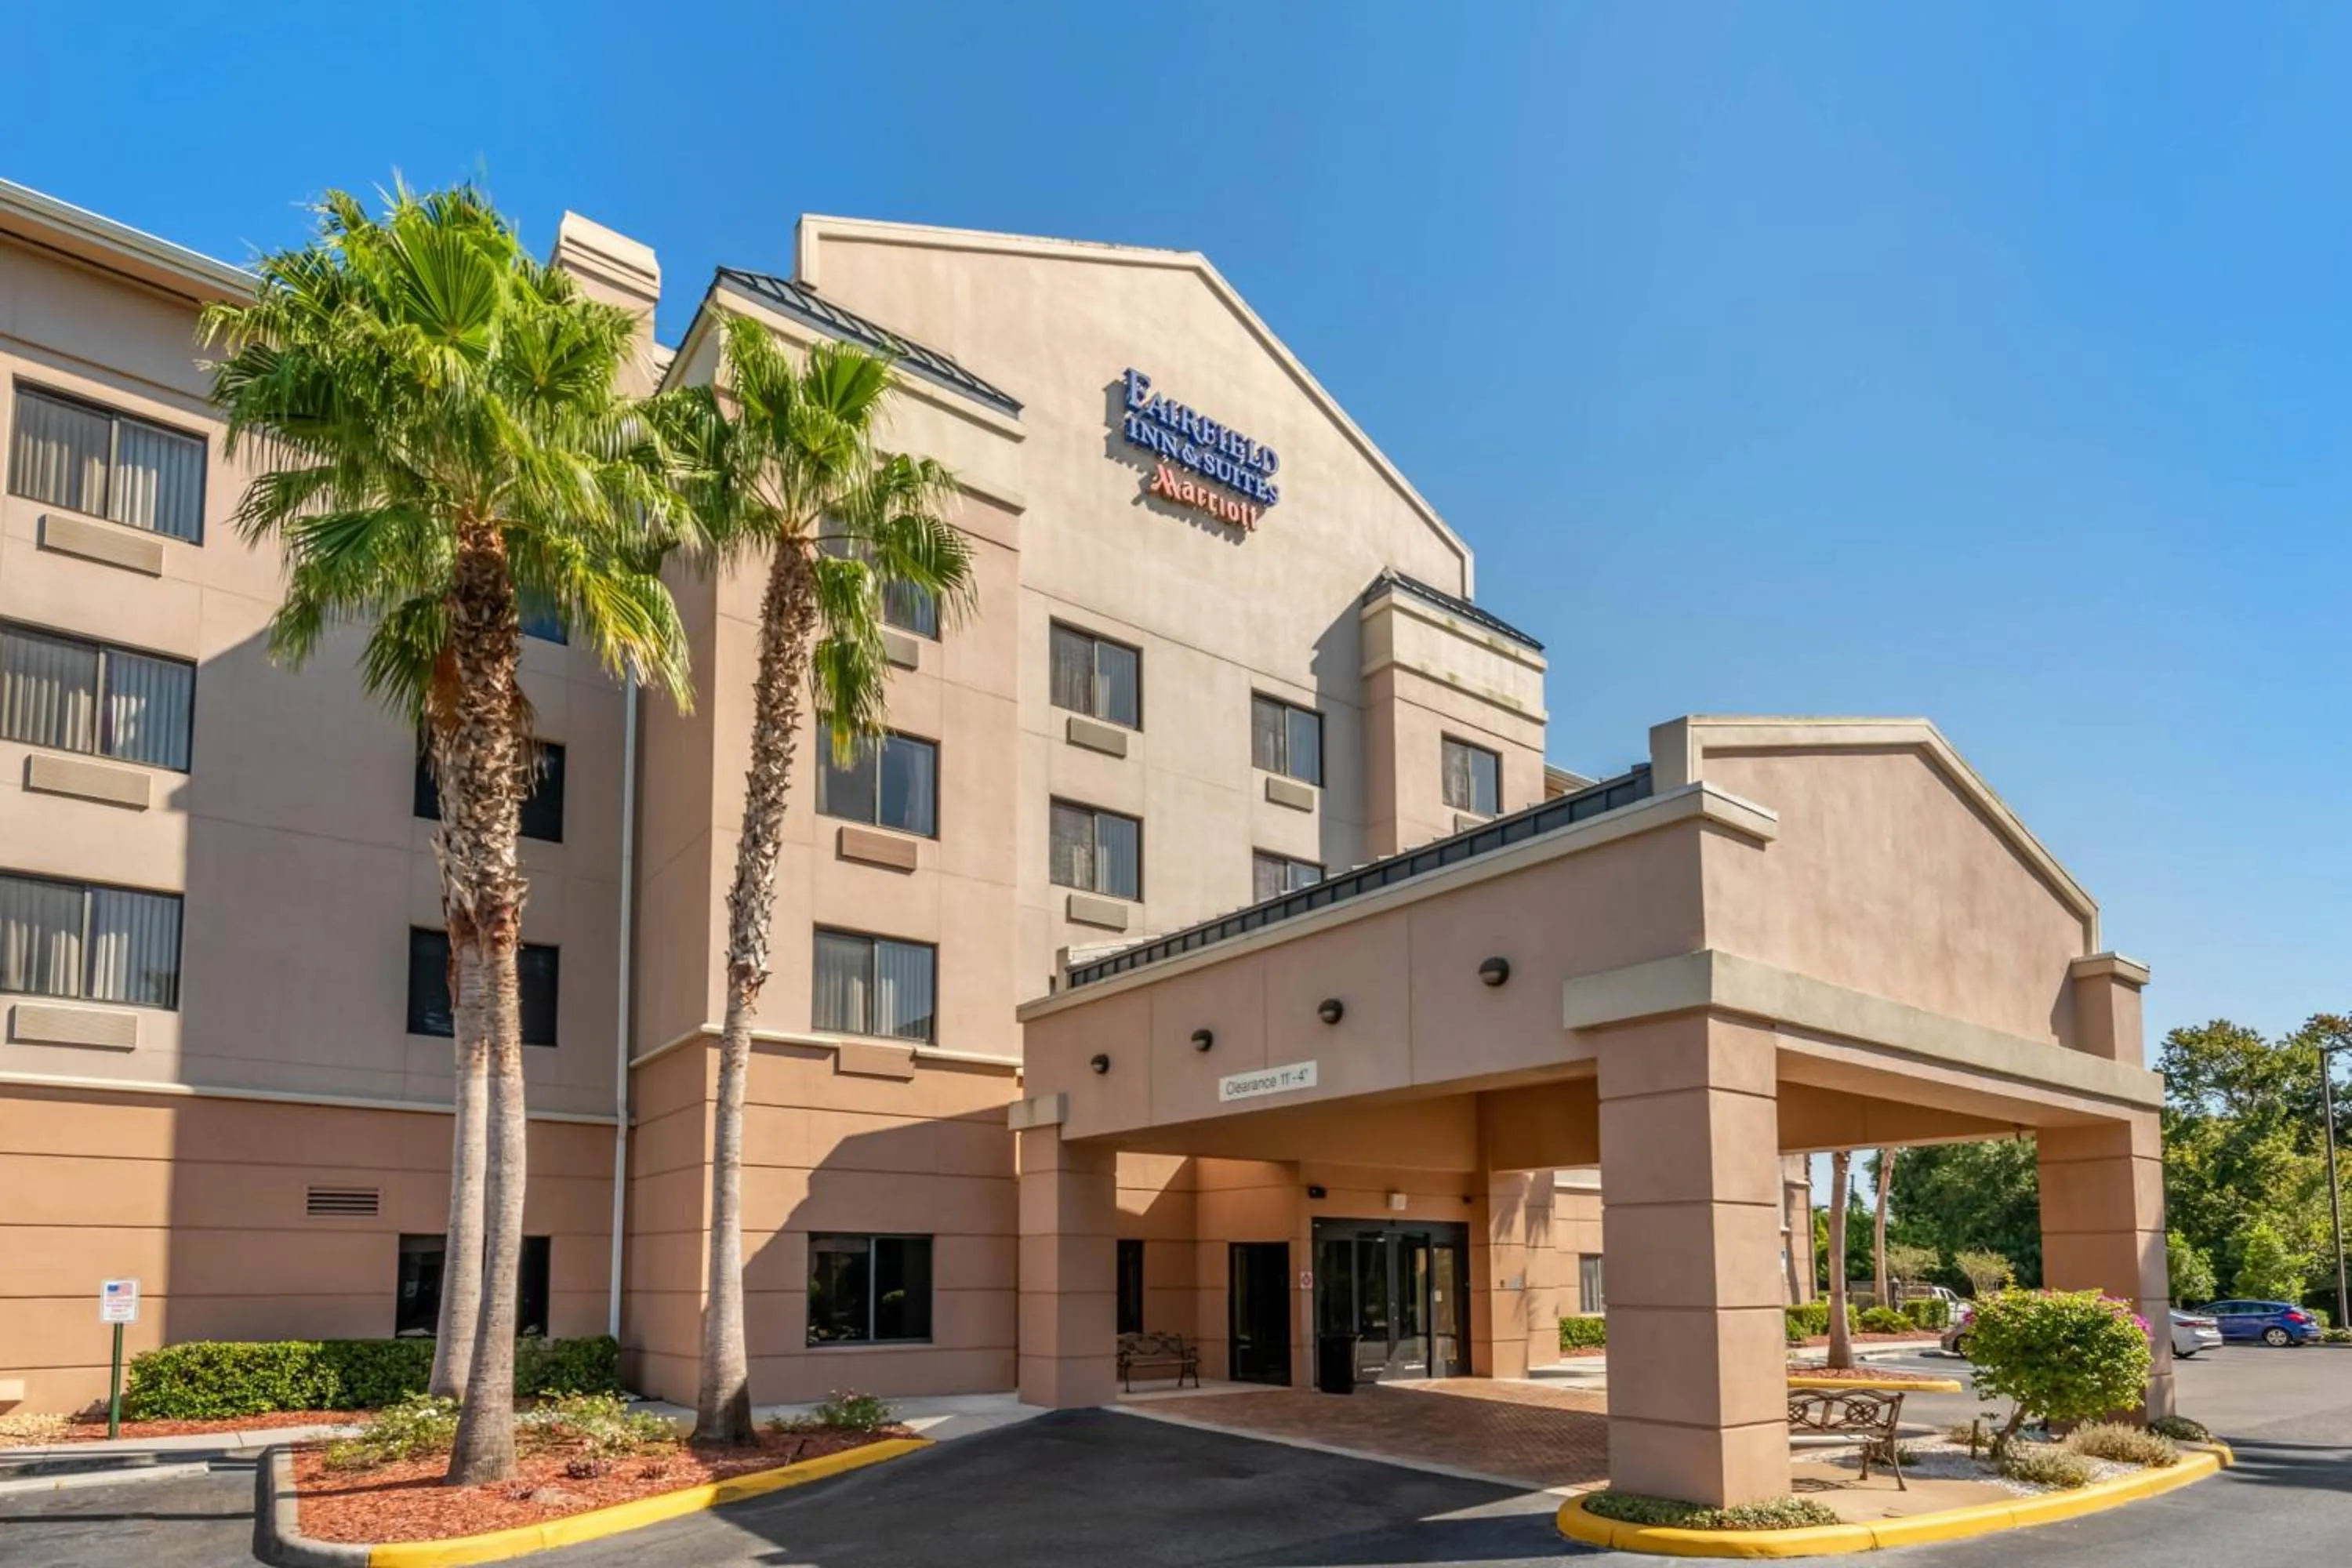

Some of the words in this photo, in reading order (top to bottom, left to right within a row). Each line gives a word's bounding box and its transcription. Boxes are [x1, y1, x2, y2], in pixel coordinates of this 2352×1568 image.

[1123, 368, 1279, 477] FAIRFIELD
[1124, 416, 1179, 460] INN
[1181, 445, 1200, 470] &
[1203, 452, 1279, 507] SUITES
[1149, 463, 1258, 532] Marriott
[1225, 1076, 1276, 1094] Clearance
